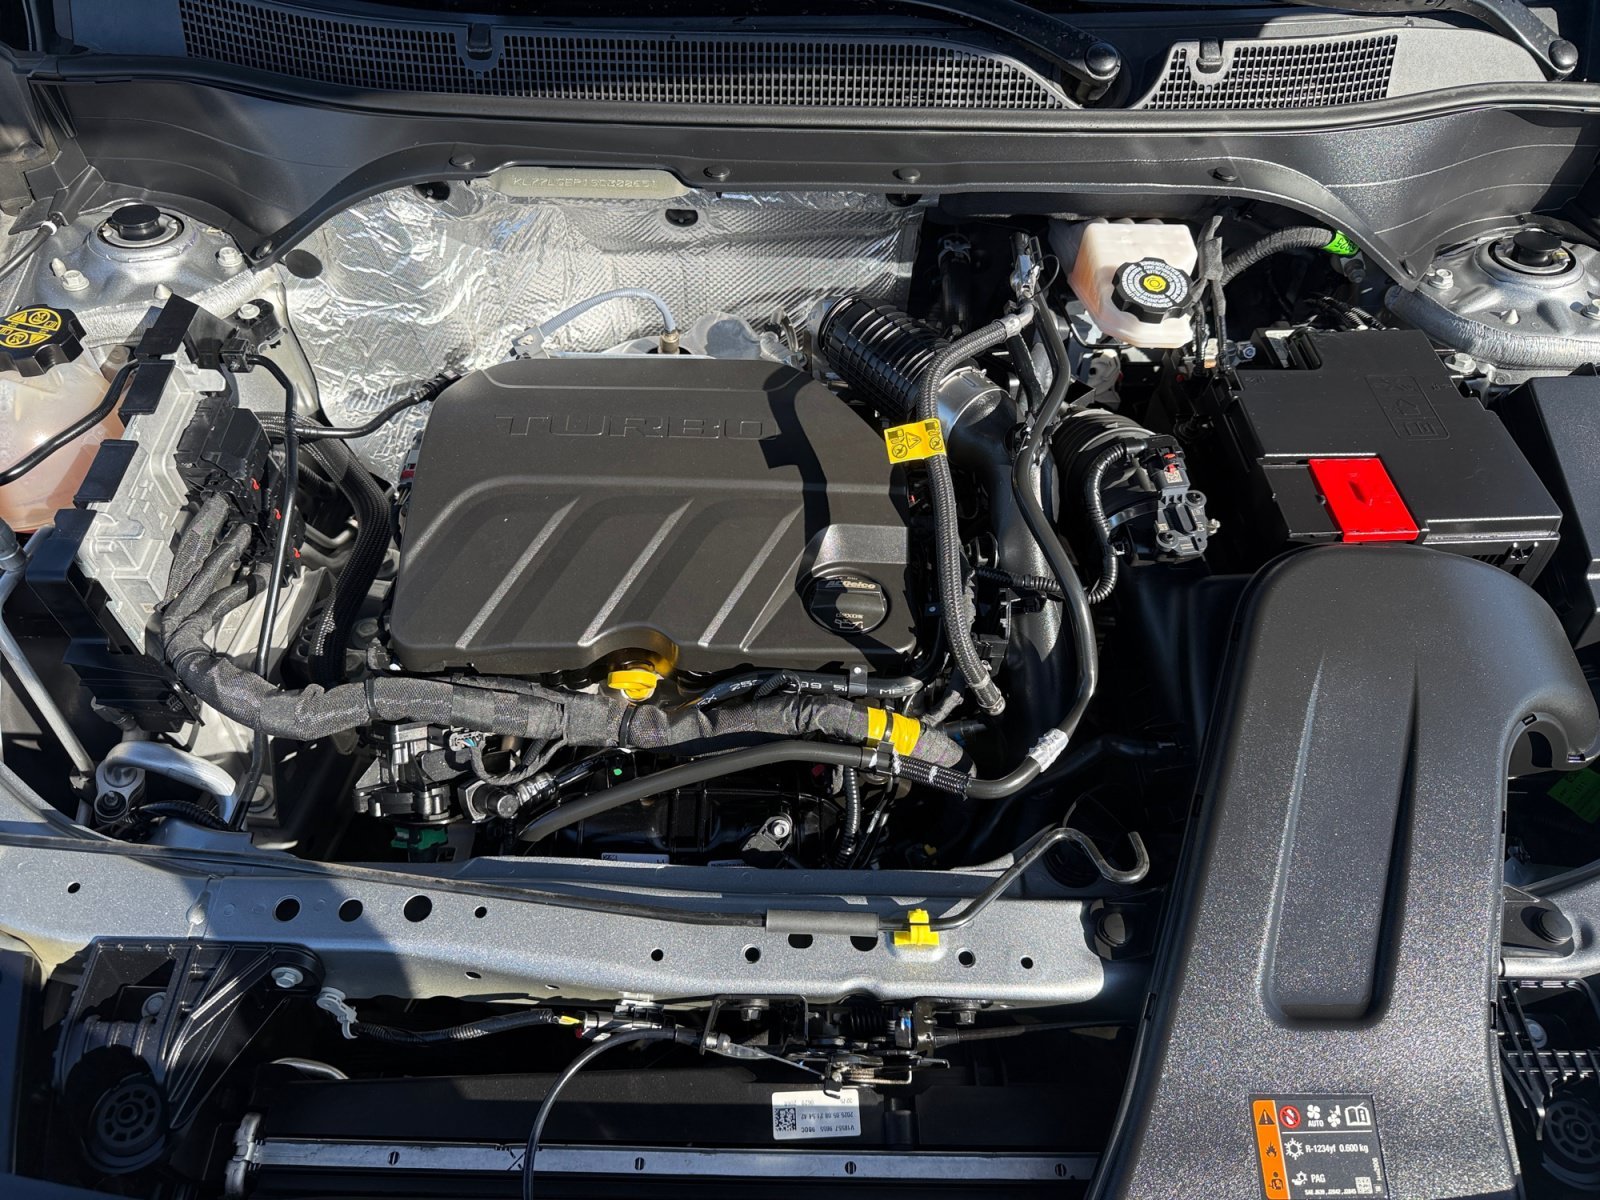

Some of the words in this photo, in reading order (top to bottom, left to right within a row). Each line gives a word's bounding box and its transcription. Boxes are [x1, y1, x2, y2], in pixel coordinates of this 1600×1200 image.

[495, 415, 777, 440] TURBO
[1305, 1144, 1336, 1154] R-1234yf
[1339, 1143, 1358, 1152] 0.600
[1359, 1143, 1369, 1153] kg
[1310, 1173, 1326, 1183] PAG
